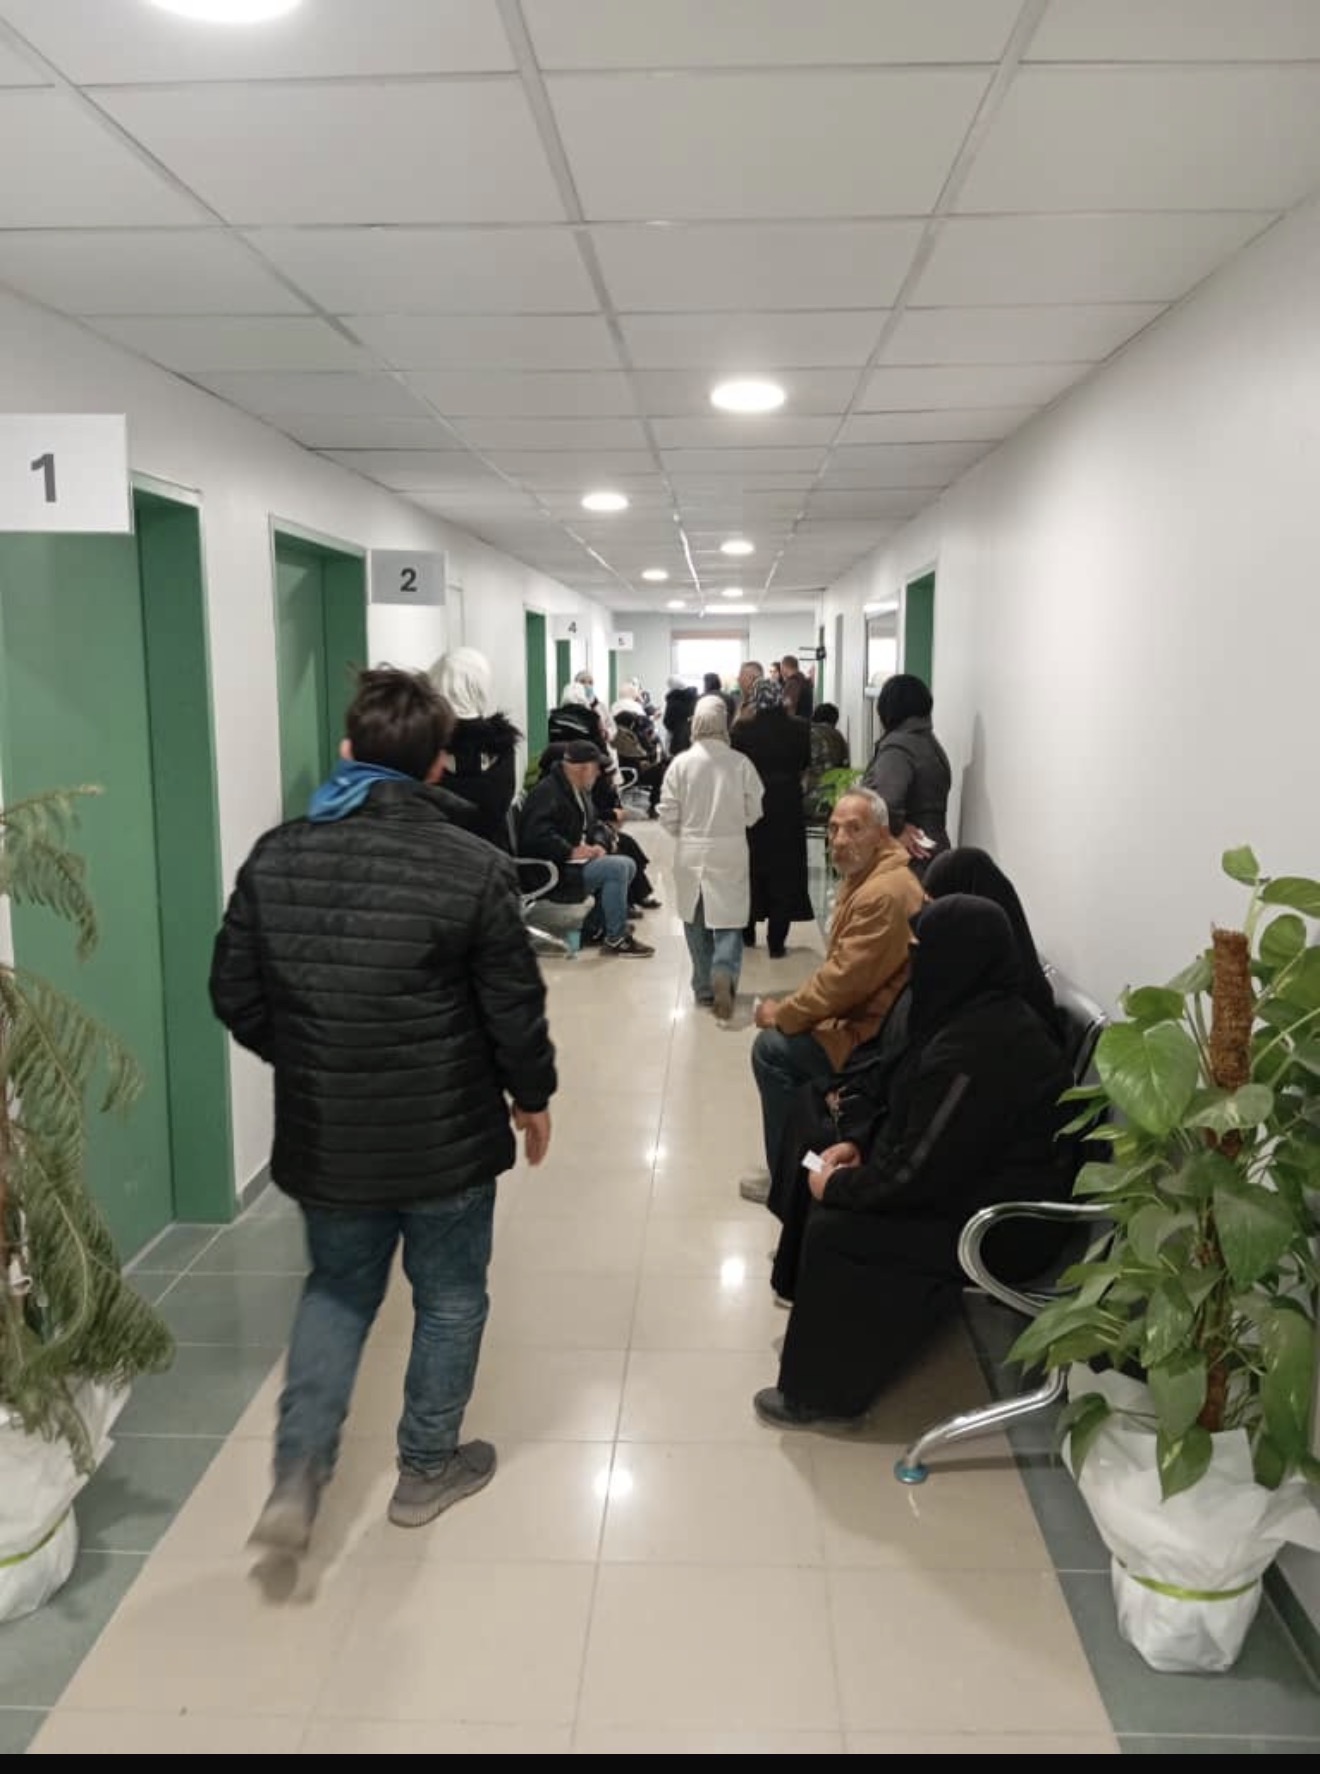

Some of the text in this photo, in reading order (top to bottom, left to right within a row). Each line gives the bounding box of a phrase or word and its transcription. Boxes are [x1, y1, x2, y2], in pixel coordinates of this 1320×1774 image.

[30, 453, 57, 503] 1
[400, 567, 417, 593] 2
[568, 621, 577, 634] 4
